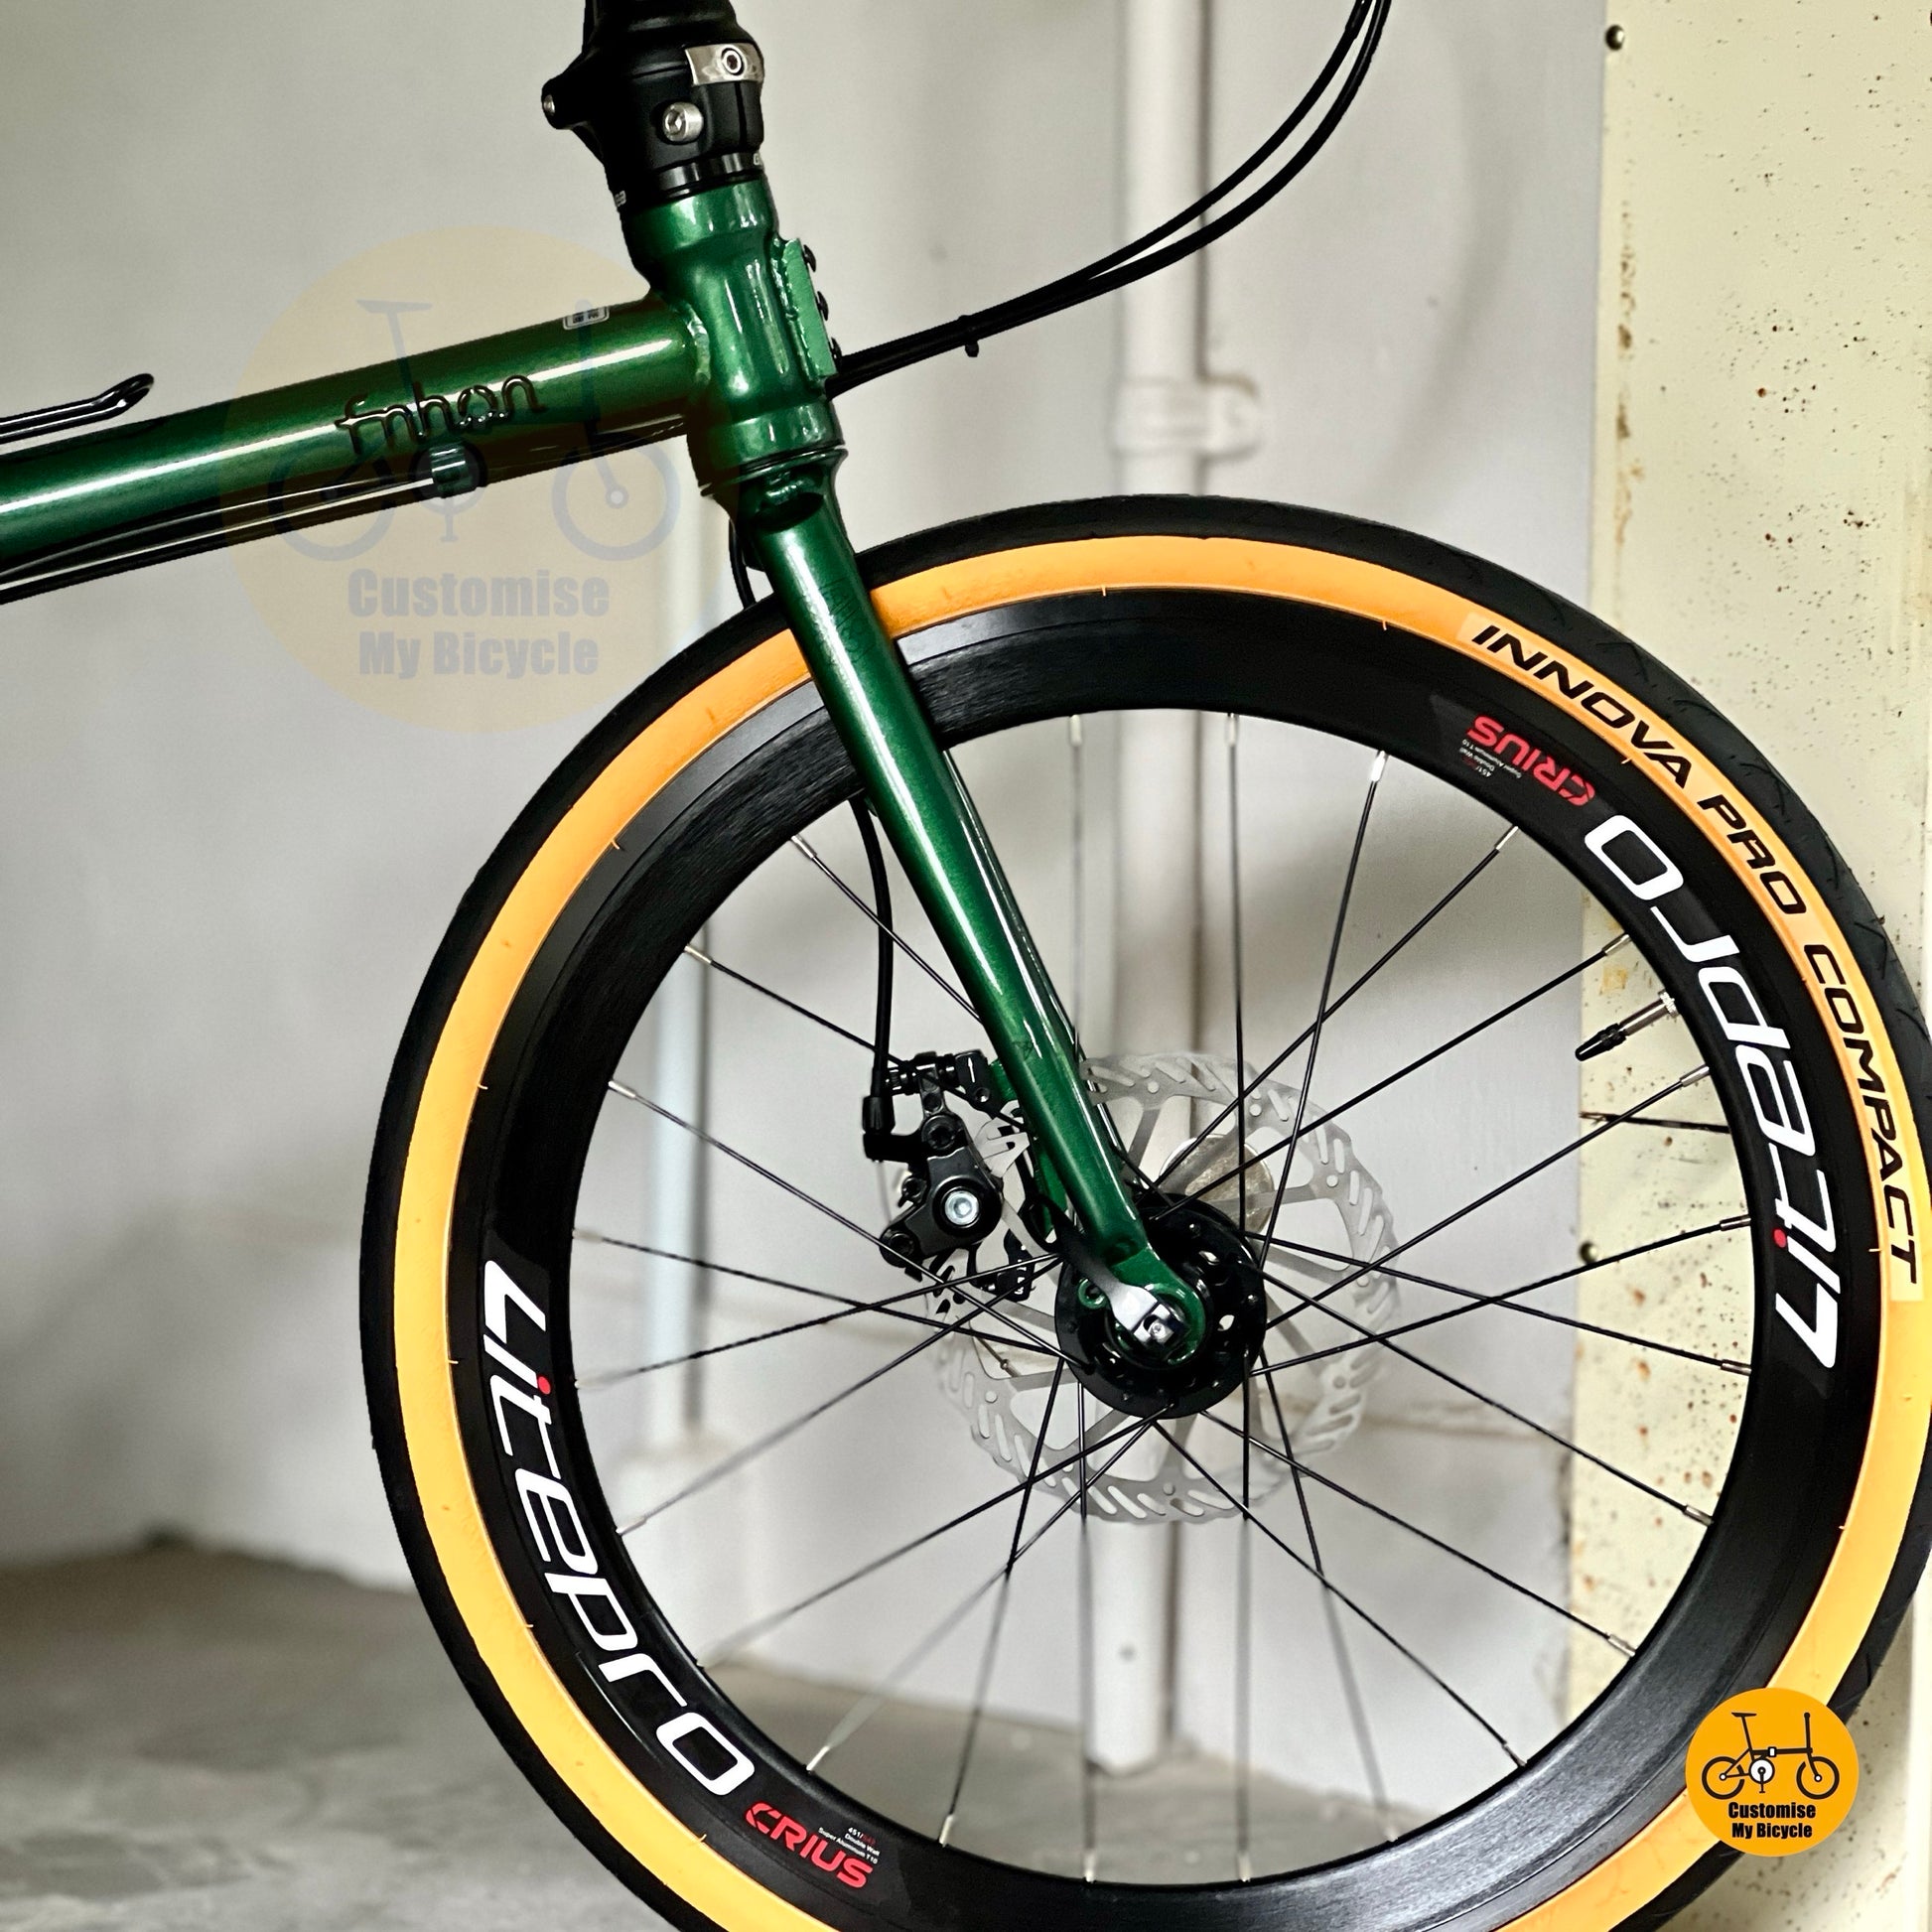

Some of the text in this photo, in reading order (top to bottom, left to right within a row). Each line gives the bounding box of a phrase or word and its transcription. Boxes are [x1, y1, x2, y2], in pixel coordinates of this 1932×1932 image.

[1466, 715, 1595, 806] CRIUS
[1471, 624, 1918, 1285] INNOVA PRO COMPACT
[483, 1260, 756, 1796] Litepro
[744, 1800, 874, 1888] CRIUS
